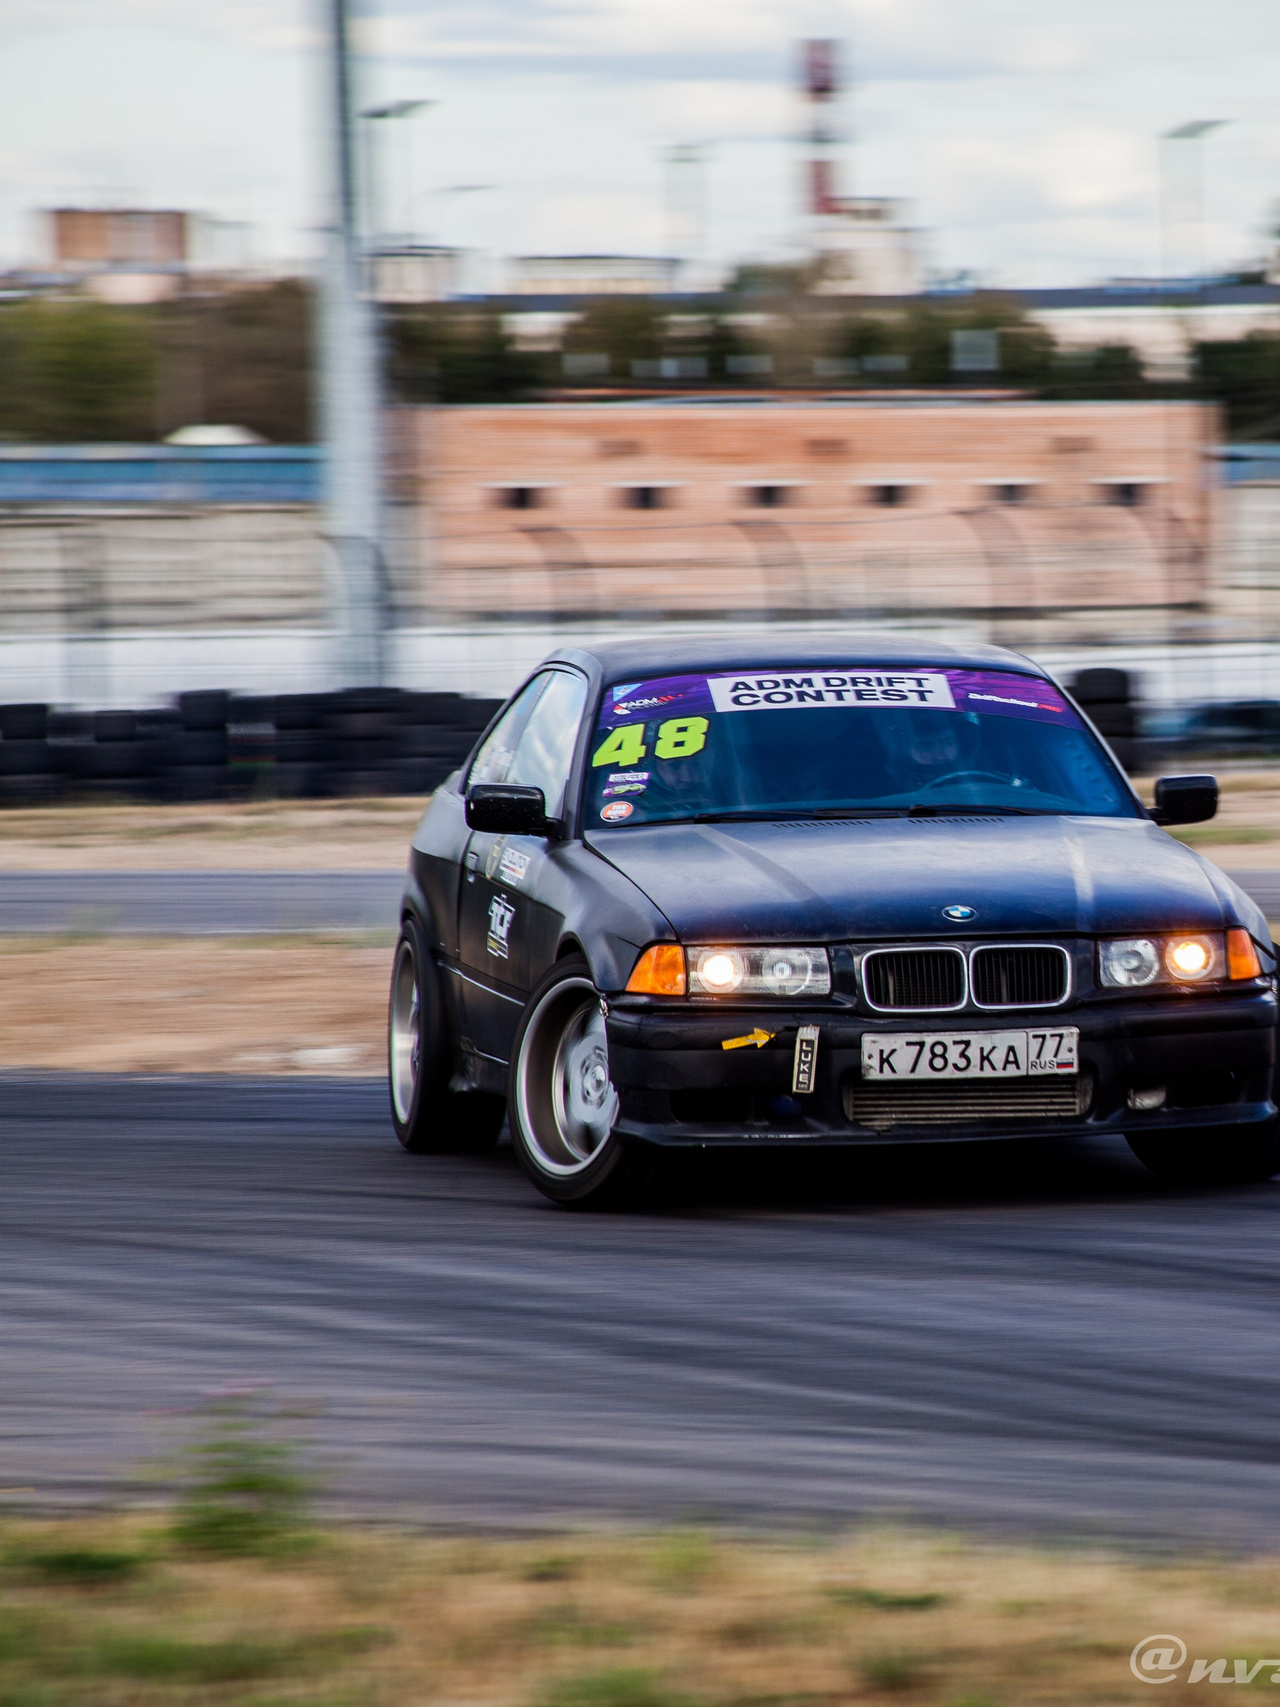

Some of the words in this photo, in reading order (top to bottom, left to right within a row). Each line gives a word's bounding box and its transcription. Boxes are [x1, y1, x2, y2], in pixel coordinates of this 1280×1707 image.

[730, 677, 814, 693] ADM
[823, 676, 929, 689] DRIFT
[731, 688, 934, 706] CONTEST
[592, 716, 709, 767] 48
[1032, 1033, 1064, 1059] 77
[798, 1041, 812, 1084] LUKE
[1030, 1060, 1055, 1071] RUS
